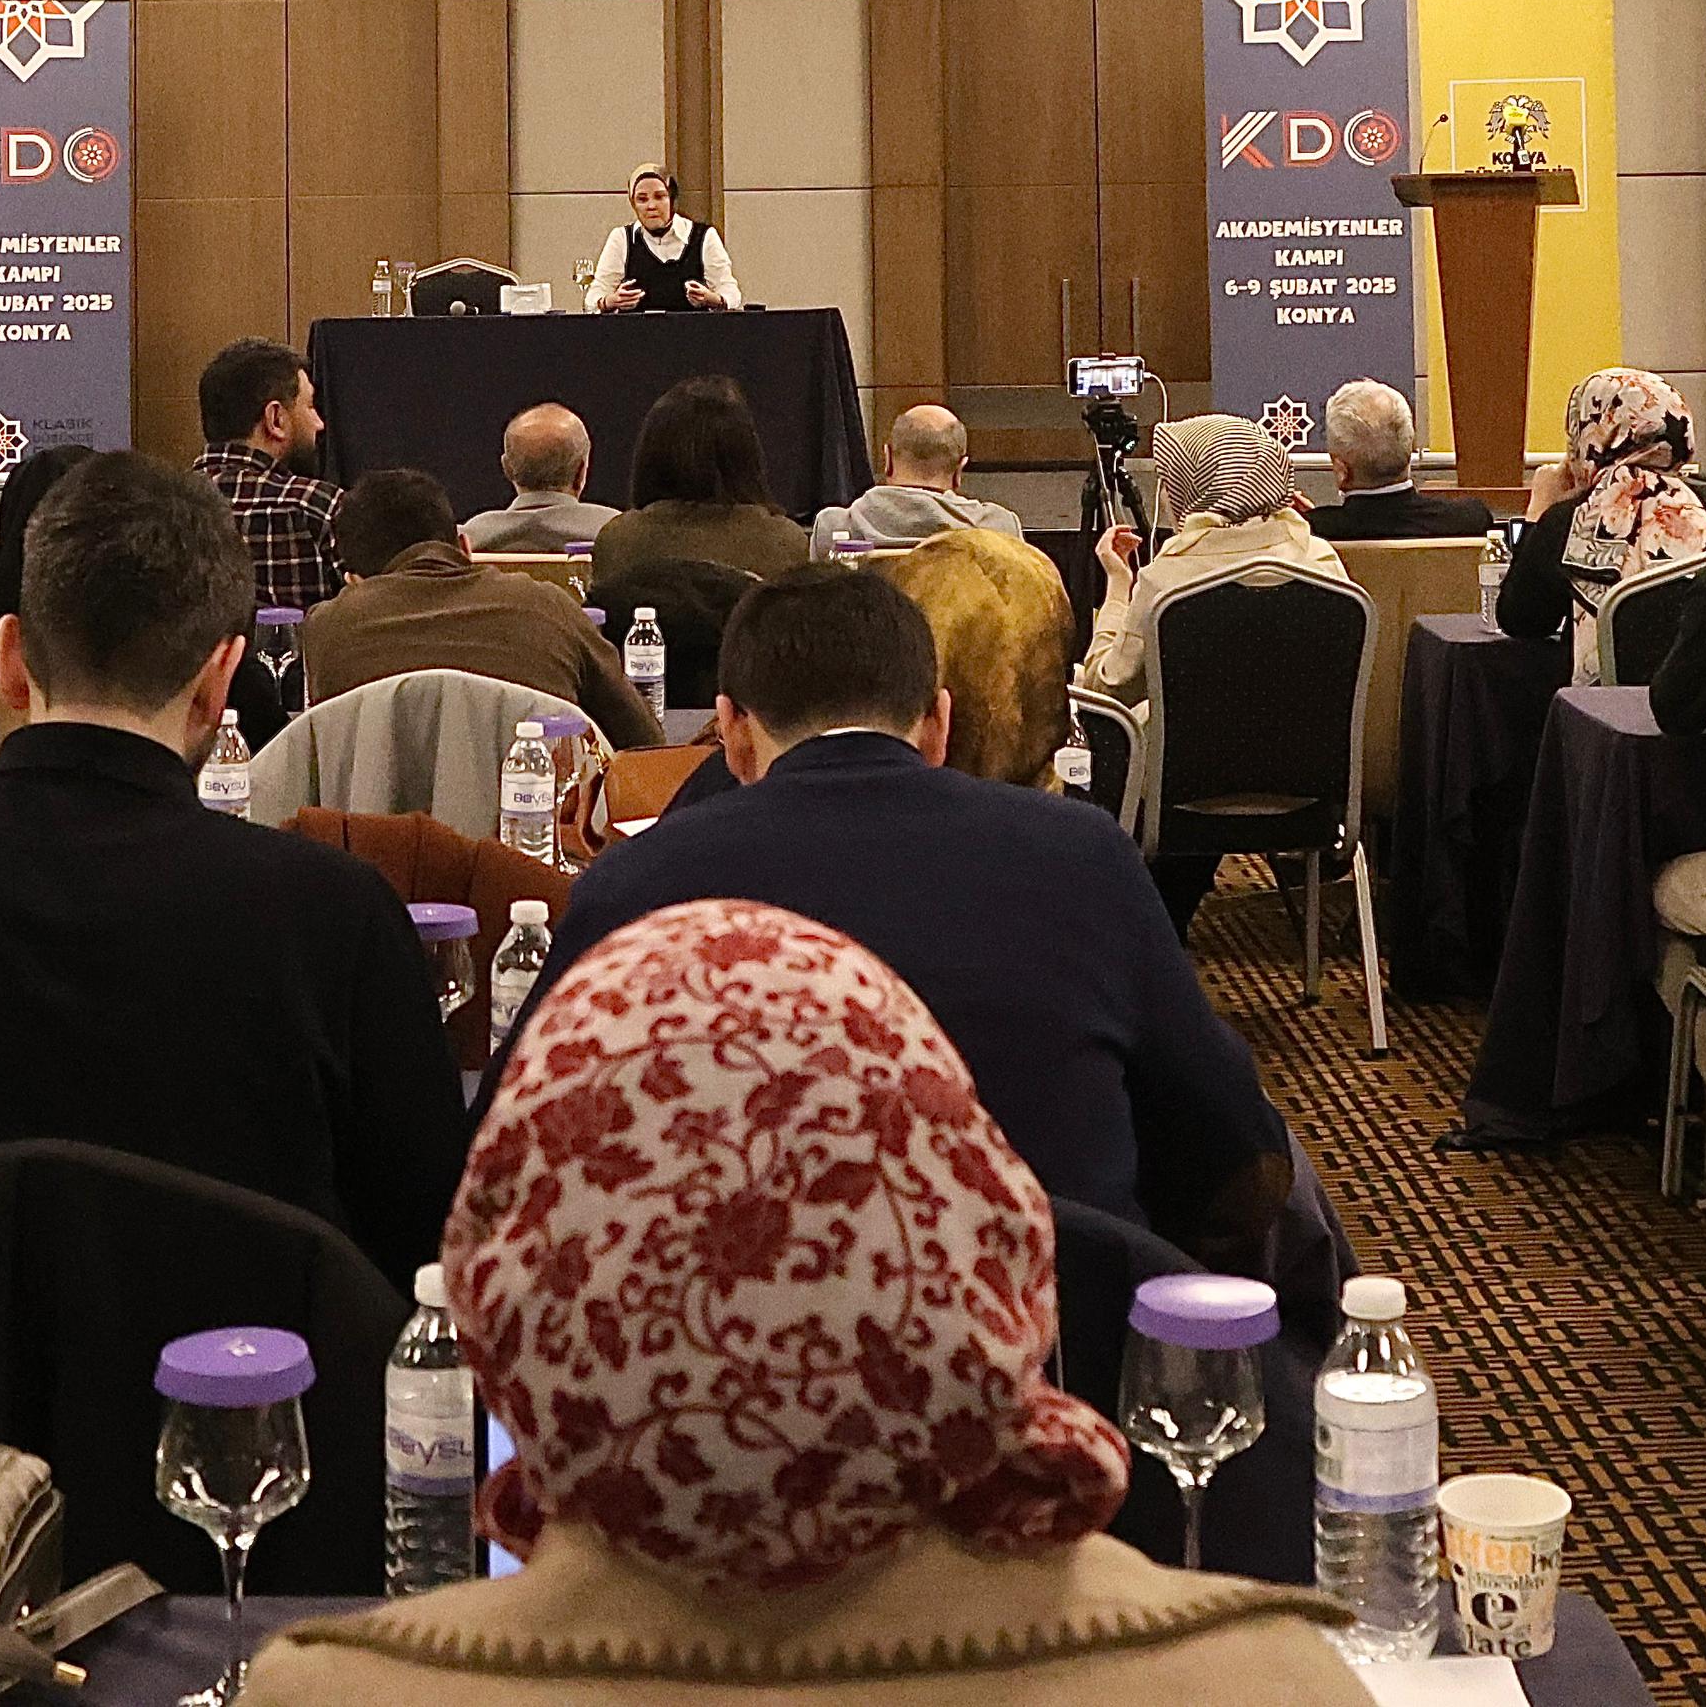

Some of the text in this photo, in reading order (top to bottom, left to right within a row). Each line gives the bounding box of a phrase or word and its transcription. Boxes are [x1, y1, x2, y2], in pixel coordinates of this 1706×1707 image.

[1492, 151, 1546, 164] KOYA
[1216, 216, 1403, 238] AKADEMİSYENLER
[1275, 249, 1344, 267] KAMPI
[1224, 277, 1397, 300] 6-9 ŞUBAT 2025
[62, 294, 113, 311] 2025
[1276, 306, 1355, 325] KONYA
